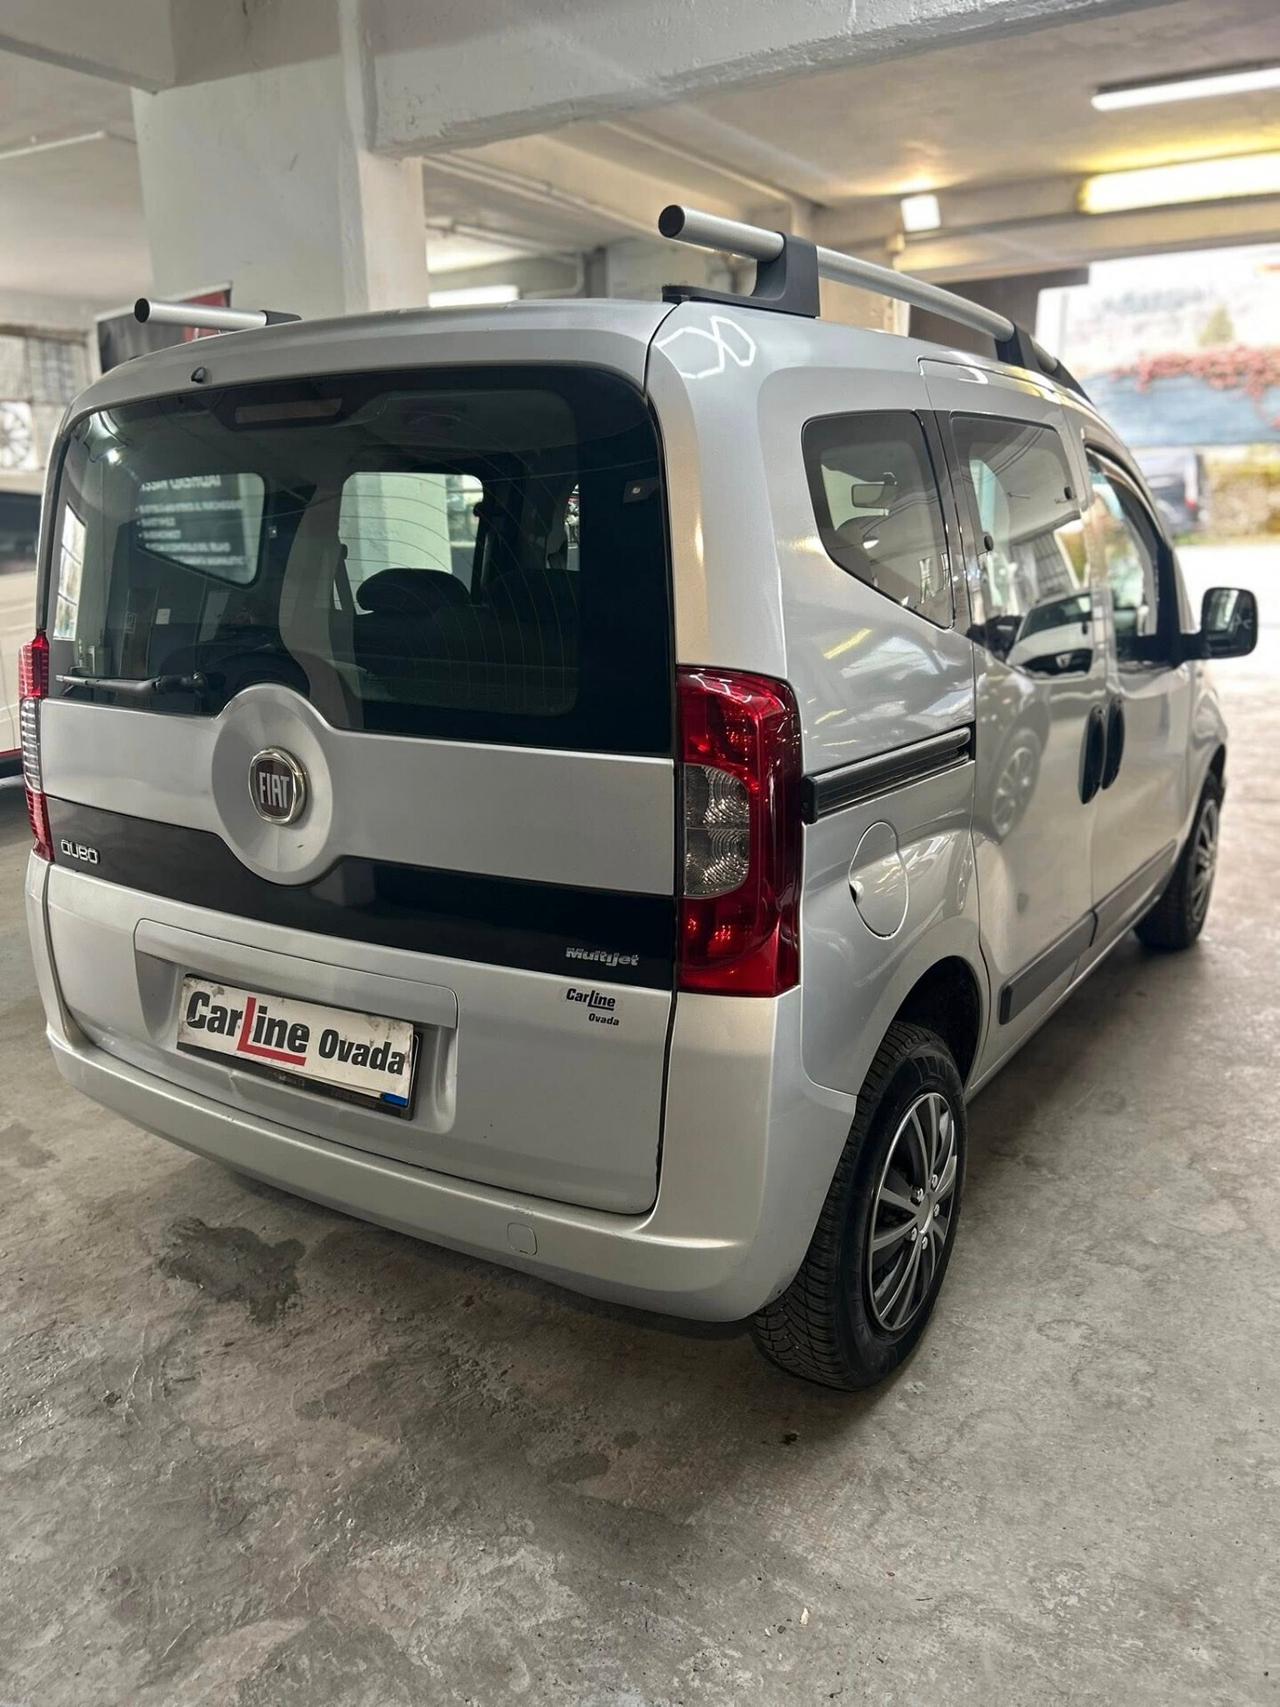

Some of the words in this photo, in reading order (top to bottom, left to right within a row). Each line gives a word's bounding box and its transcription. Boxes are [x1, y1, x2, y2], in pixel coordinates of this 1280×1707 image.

[258, 771, 290, 809] FIAT
[60, 839, 98, 865] QUBO
[565, 946, 640, 967] Multijet
[588, 1012, 620, 1026] Ovada
[318, 1028, 406, 1076] Ovada
